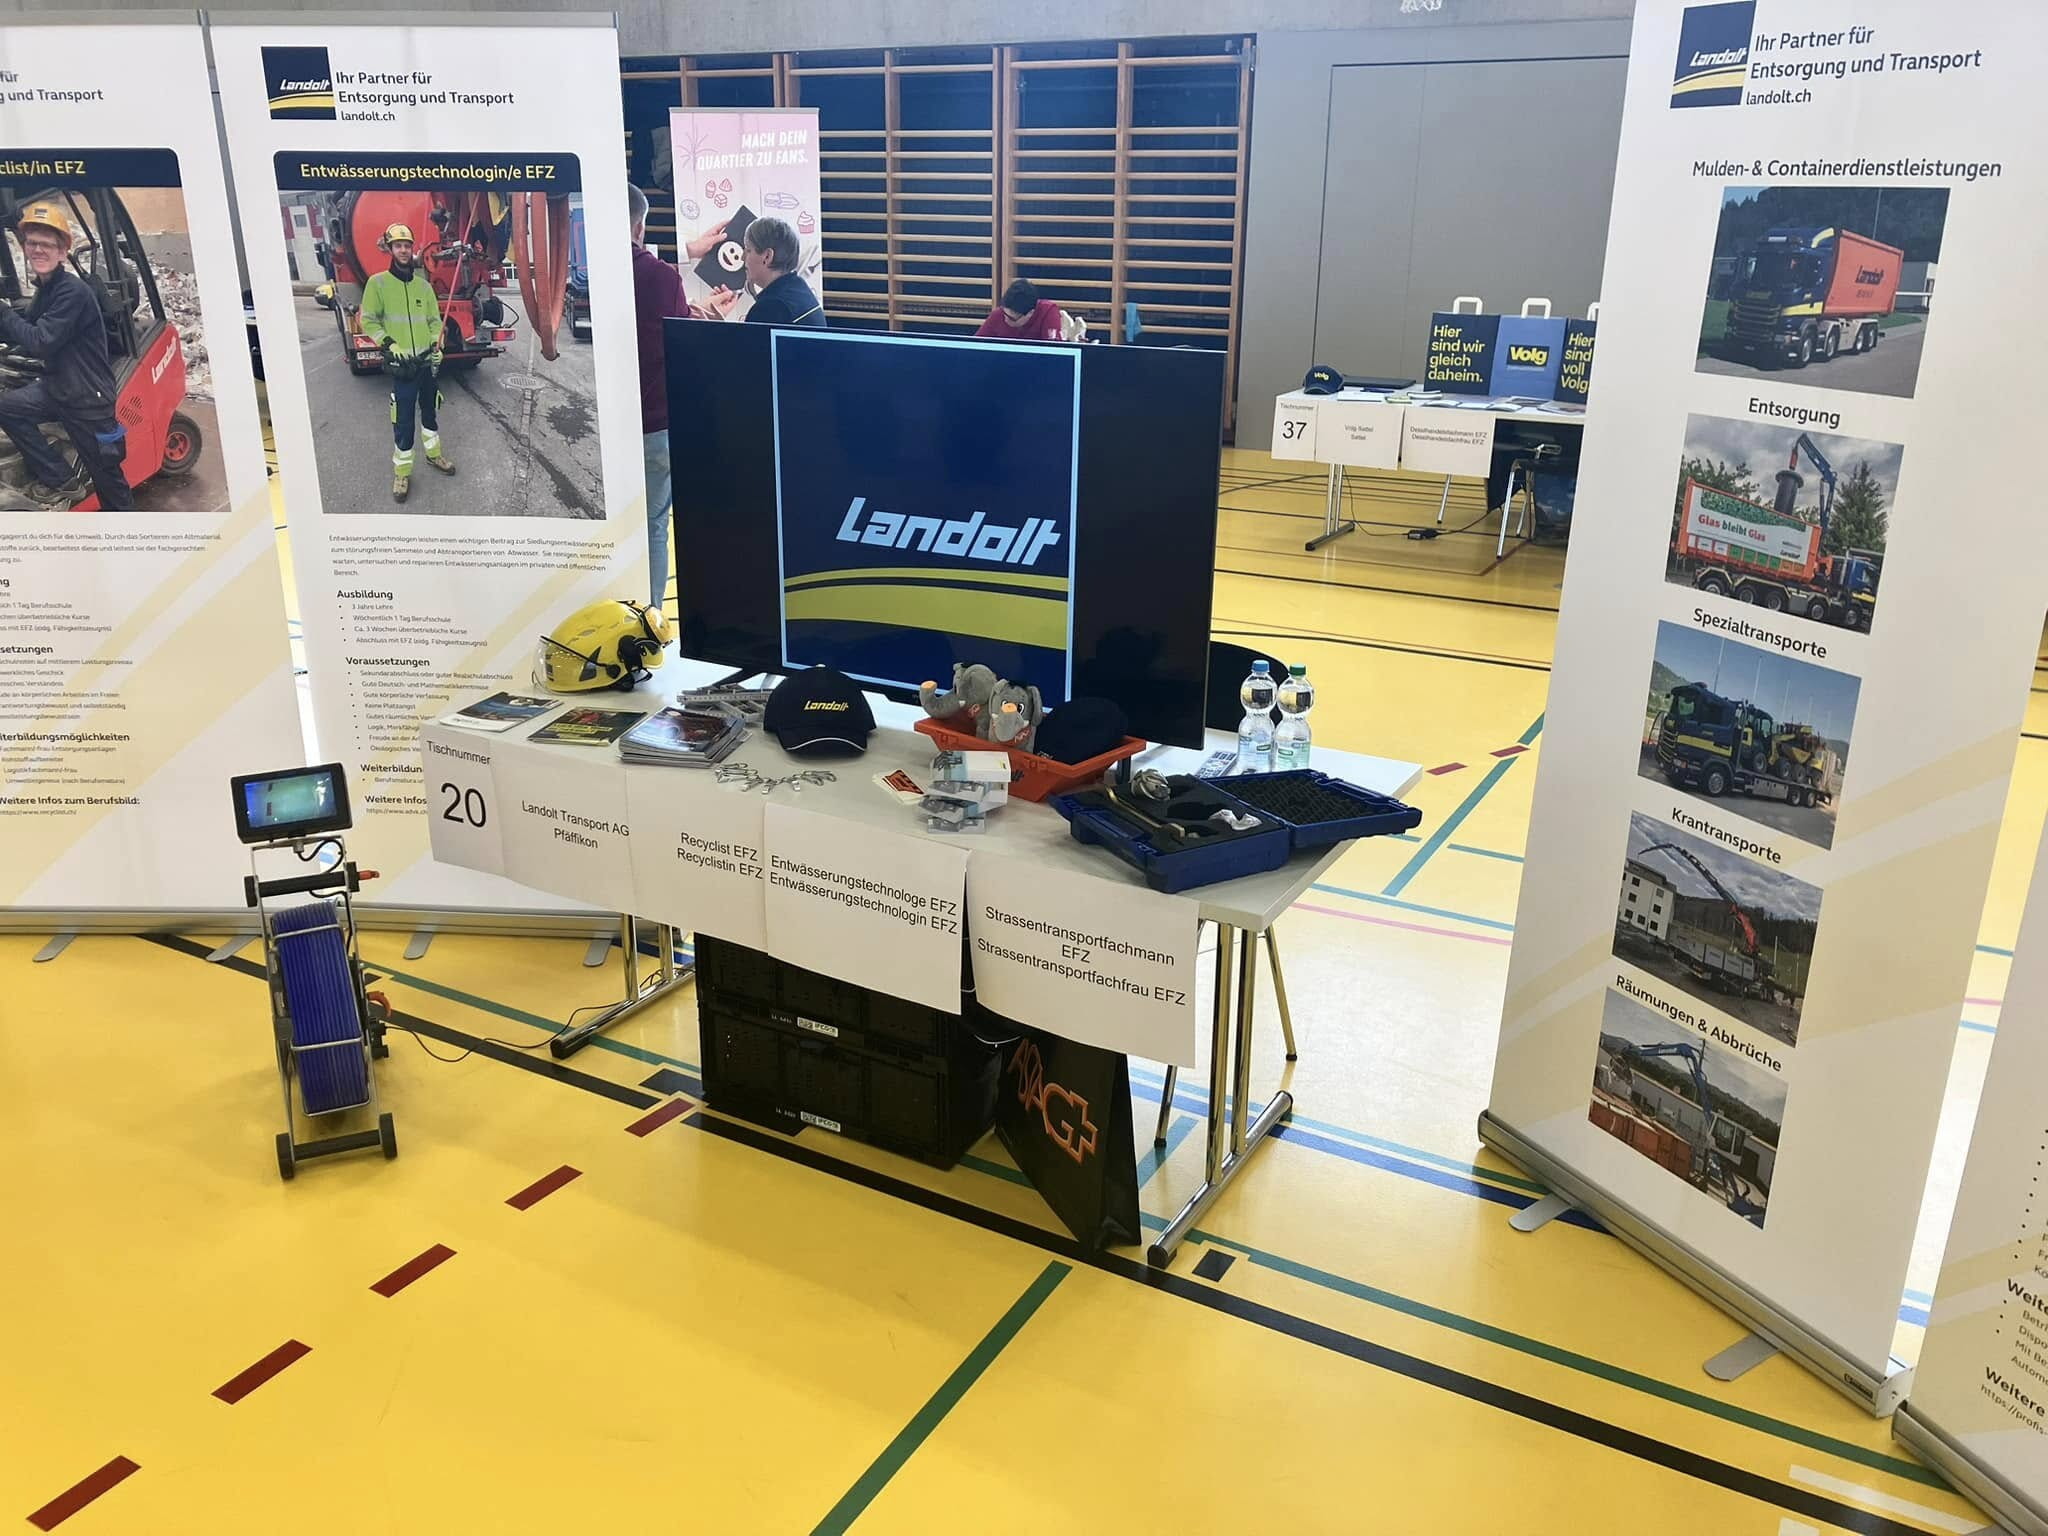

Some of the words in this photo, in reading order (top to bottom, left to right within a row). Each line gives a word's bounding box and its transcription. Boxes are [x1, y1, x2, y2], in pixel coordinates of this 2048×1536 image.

[1755, 34, 1776, 52] Ihr
[1779, 30, 1845, 52] Partner
[1848, 26, 1875, 45] für
[1689, 47, 1748, 67] Landolt
[1750, 59, 1846, 80] Entsorgung
[1850, 54, 1885, 73] und
[1889, 49, 1982, 74] Transport
[279, 78, 331, 91] Landolt
[336, 71, 355, 85] Ihr
[358, 71, 409, 85] Partner
[412, 71, 433, 85] für
[8, 88, 34, 101] und
[36, 88, 104, 103] Transport
[339, 91, 416, 106] Entsorgung
[419, 91, 447, 104] und
[449, 91, 515, 107] Transport
[1745, 88, 1812, 106] landolt.ch
[341, 111, 396, 121] landolt.ch
[741, 132, 776, 149] MACH
[778, 129, 808, 147] DEIN
[54, 160, 87, 174] EFZ
[697, 152, 754, 171] QUARTIER
[756, 151, 773, 167] ZU
[1692, 159, 1750, 177] Mulden-
[1751, 160, 1763, 176] &
[1767, 158, 2002, 181] Containerdienstleistungen
[300, 163, 522, 182] Entwässerungstechnologin/e
[525, 164, 556, 179] EFZ
[1433, 325, 1463, 338] Hier
[1568, 332, 1595, 346] Hier
[1431, 339, 1461, 352] sind
[1463, 340, 1486, 353] wir
[1510, 346, 1548, 366] Volg
[1564, 347, 1592, 362] sind
[1429, 353, 1471, 368] gleich
[1562, 362, 1585, 376] voll
[1428, 368, 1484, 383] daheim.
[1748, 397, 1841, 429] Entsorgung
[1282, 420, 1308, 440] 37
[835, 497, 1061, 566] Landolt
[1698, 514, 1720, 528] Glas
[1748, 529, 1766, 542] Glas
[337, 589, 394, 601] Ausbildung
[1693, 607, 1827, 659] Spezialtransporte
[345, 656, 430, 667] Voraussetzungen
[804, 699, 849, 712] Landolt
[426, 740, 491, 766] Tischnummer
[0, 796, 37, 805] Weitere
[38, 796, 63, 805] Infos
[64, 797, 85, 805] zum
[86, 796, 141, 805] Berufsbild:
[365, 795, 402, 803] Weitere
[404, 796, 428, 805] Infos
[440, 782, 487, 828] 20
[521, 801, 559, 821] Landolt
[559, 810, 610, 833] Transport
[611, 822, 630, 838] AG
[553, 828, 599, 850] Pfäffikon
[1671, 807, 1782, 864] Krantransporte
[680, 832, 732, 857] Recyclist
[733, 844, 759, 862] EFZ
[676, 848, 737, 876] Recyclistin
[739, 862, 764, 880] EFZ
[771, 854, 928, 908] Entwässerungstechnologe
[930, 897, 958, 917] EFZ
[769, 872, 928, 927] Entwässerungstechnologin
[930, 916, 958, 935] EFZ
[985, 906, 1175, 967] Strassentransportfachmann
[1061, 944, 1091, 964] EFZ
[977, 938, 1149, 998] Strassentransportfachfrau
[1154, 986, 1186, 1006] EFZ
[1615, 974, 1695, 1030] Räumungen
[1697, 1019, 1708, 1034] &
[1710, 1026, 1782, 1073] Abbrüche
[2014, 1339, 2032, 1355] Mit
[1985, 1366, 2046, 1417] Weitere
